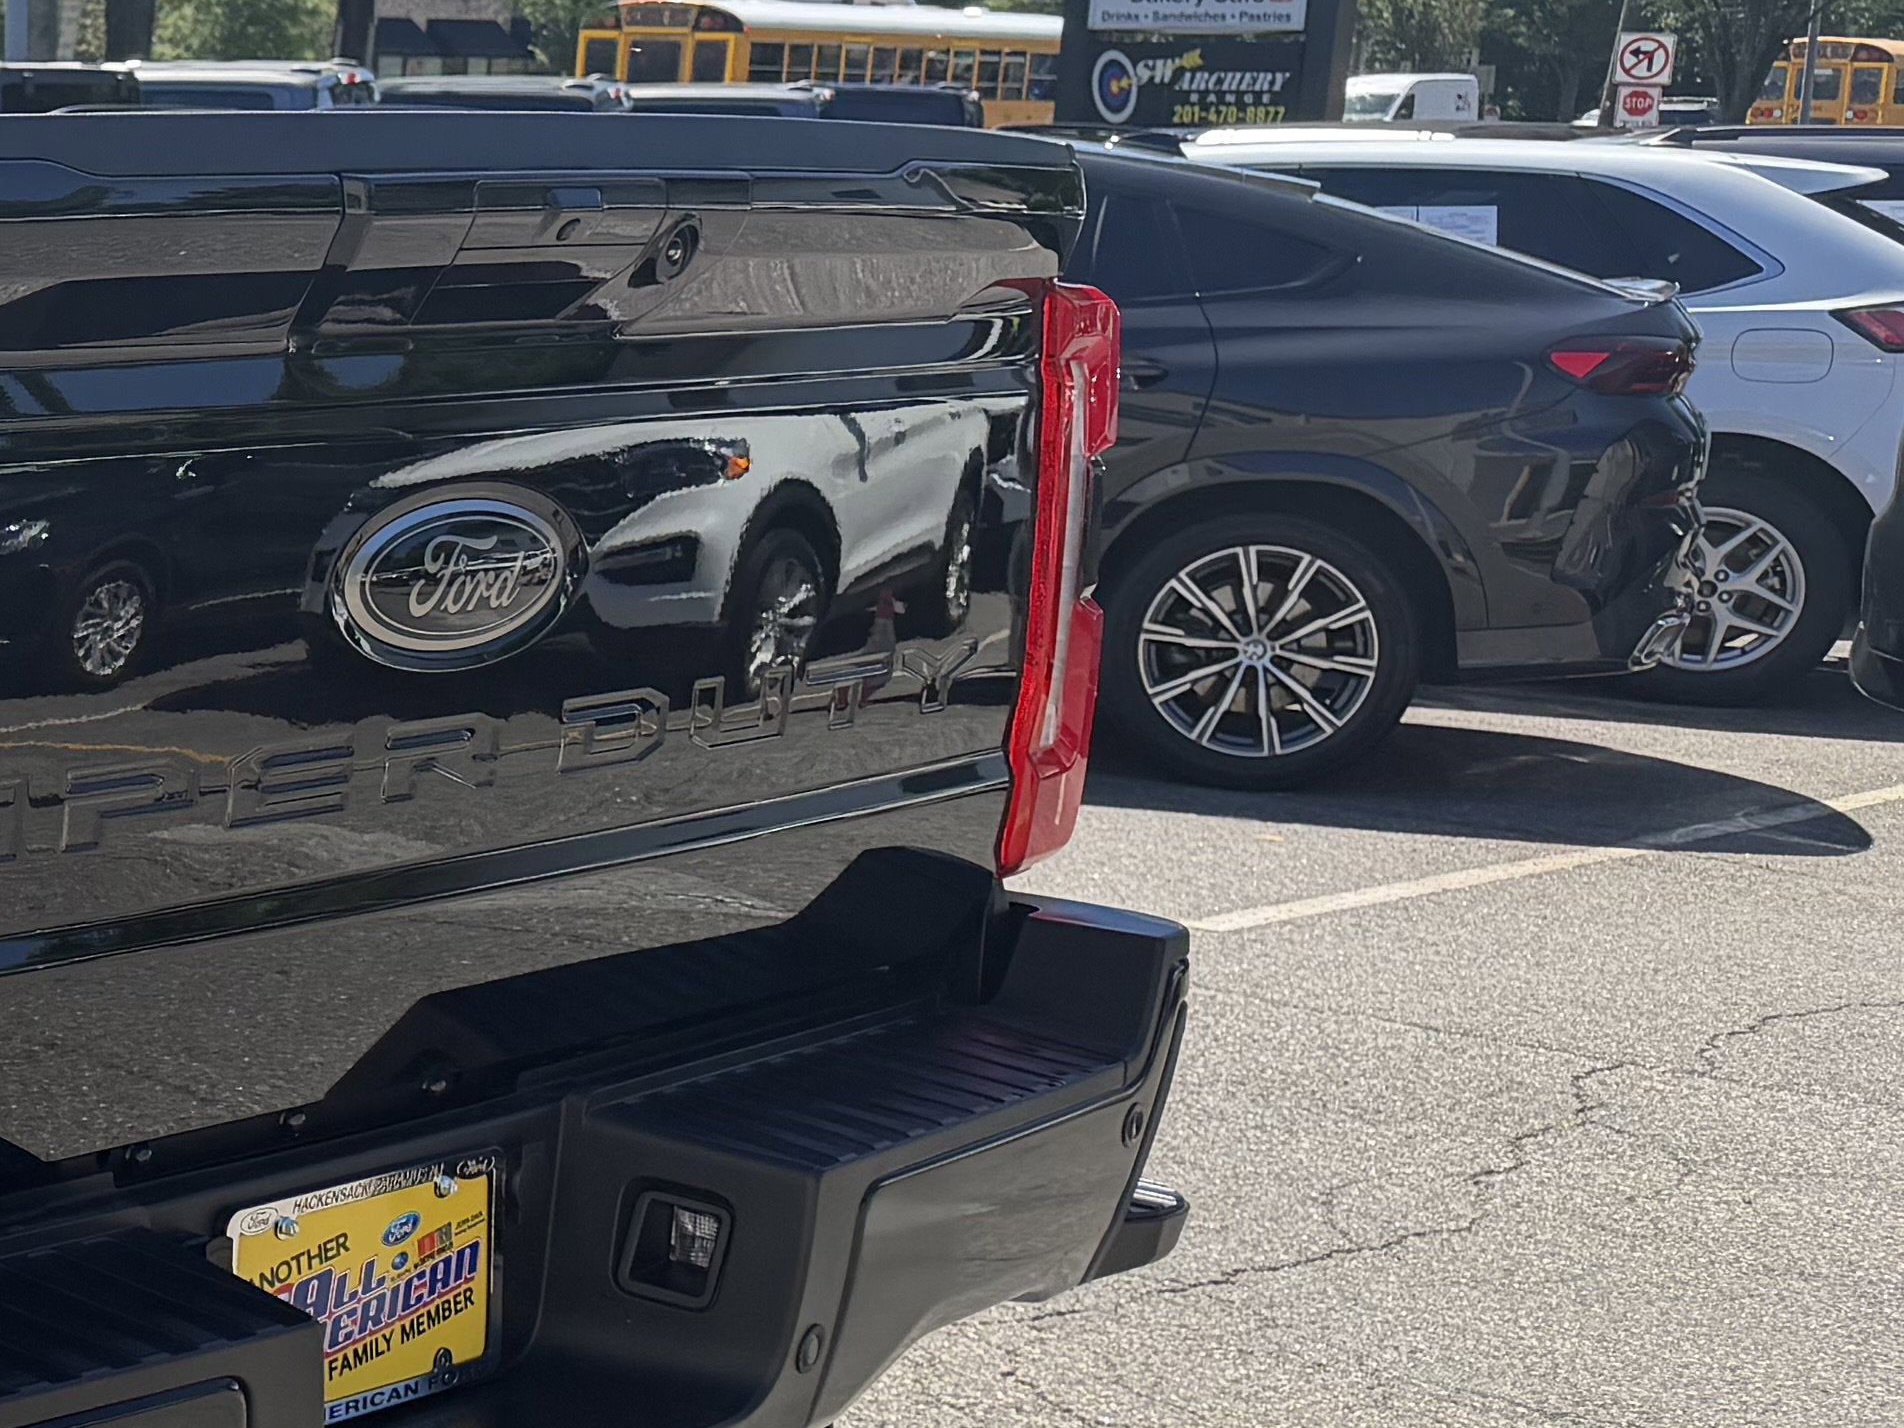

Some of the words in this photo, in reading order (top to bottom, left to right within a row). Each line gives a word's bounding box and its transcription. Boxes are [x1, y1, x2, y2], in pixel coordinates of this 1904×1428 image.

[1101, 10, 1140, 22] Drinks
[1152, 10, 1226, 22] Sandwiches
[1239, 10, 1291, 22] Pastries
[1174, 71, 1290, 91] ARCHERY
[1624, 97, 1652, 108] STOP
[409, 535, 525, 617] Ford
[556, 635, 978, 772] DUTY
[327, 1331, 393, 1381] FAMILY
[400, 1288, 475, 1344] MEMBER
[325, 1382, 420, 1421] ERICAN
